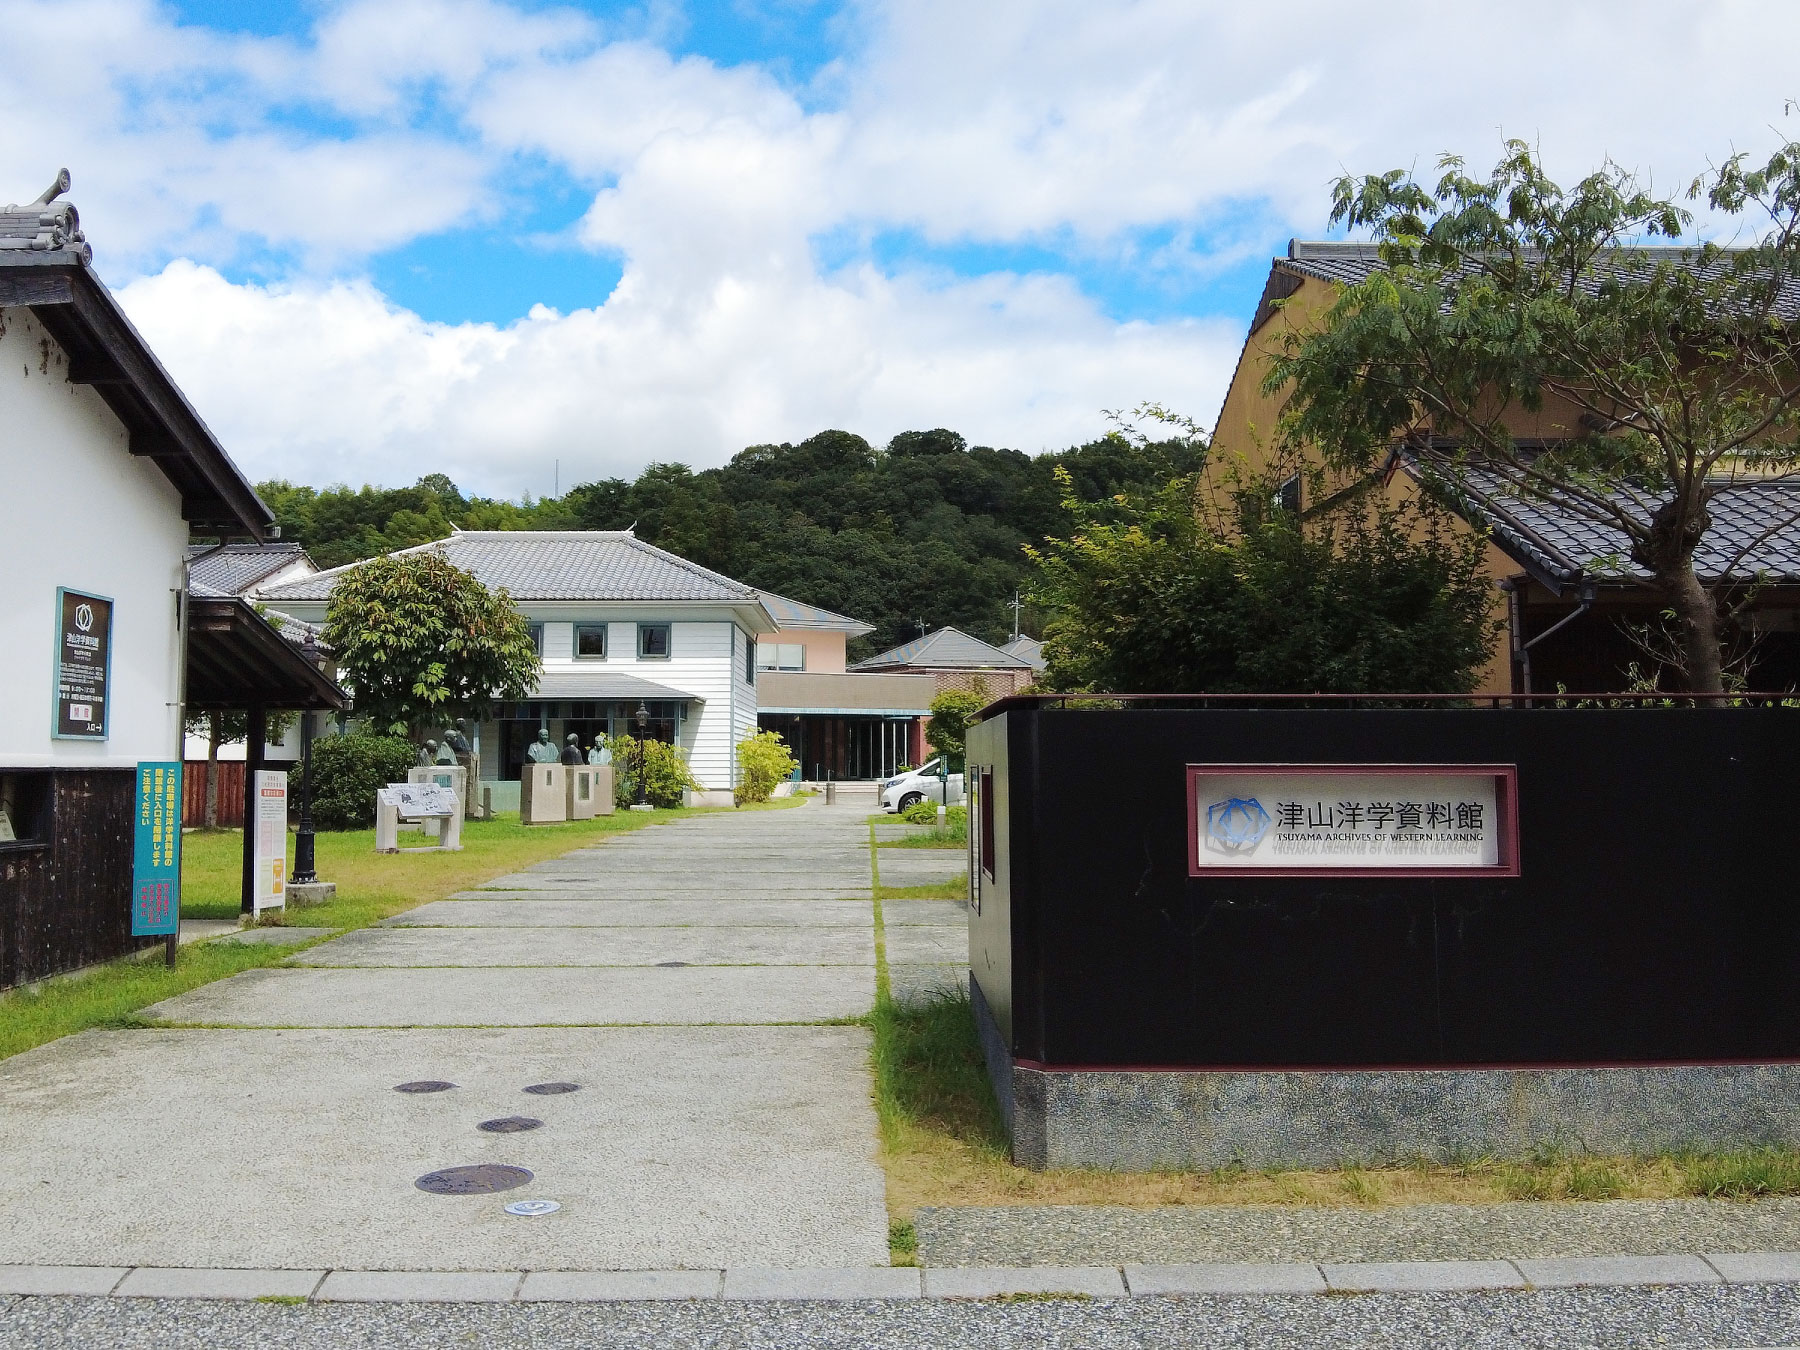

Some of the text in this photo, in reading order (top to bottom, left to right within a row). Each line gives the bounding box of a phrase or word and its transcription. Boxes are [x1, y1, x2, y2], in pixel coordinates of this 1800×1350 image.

[1276, 801, 1484, 829] 津山洋学資料館
[1277, 832, 1484, 841] TSUYAMA ARCHIVES OF WESTERN LEARNING
